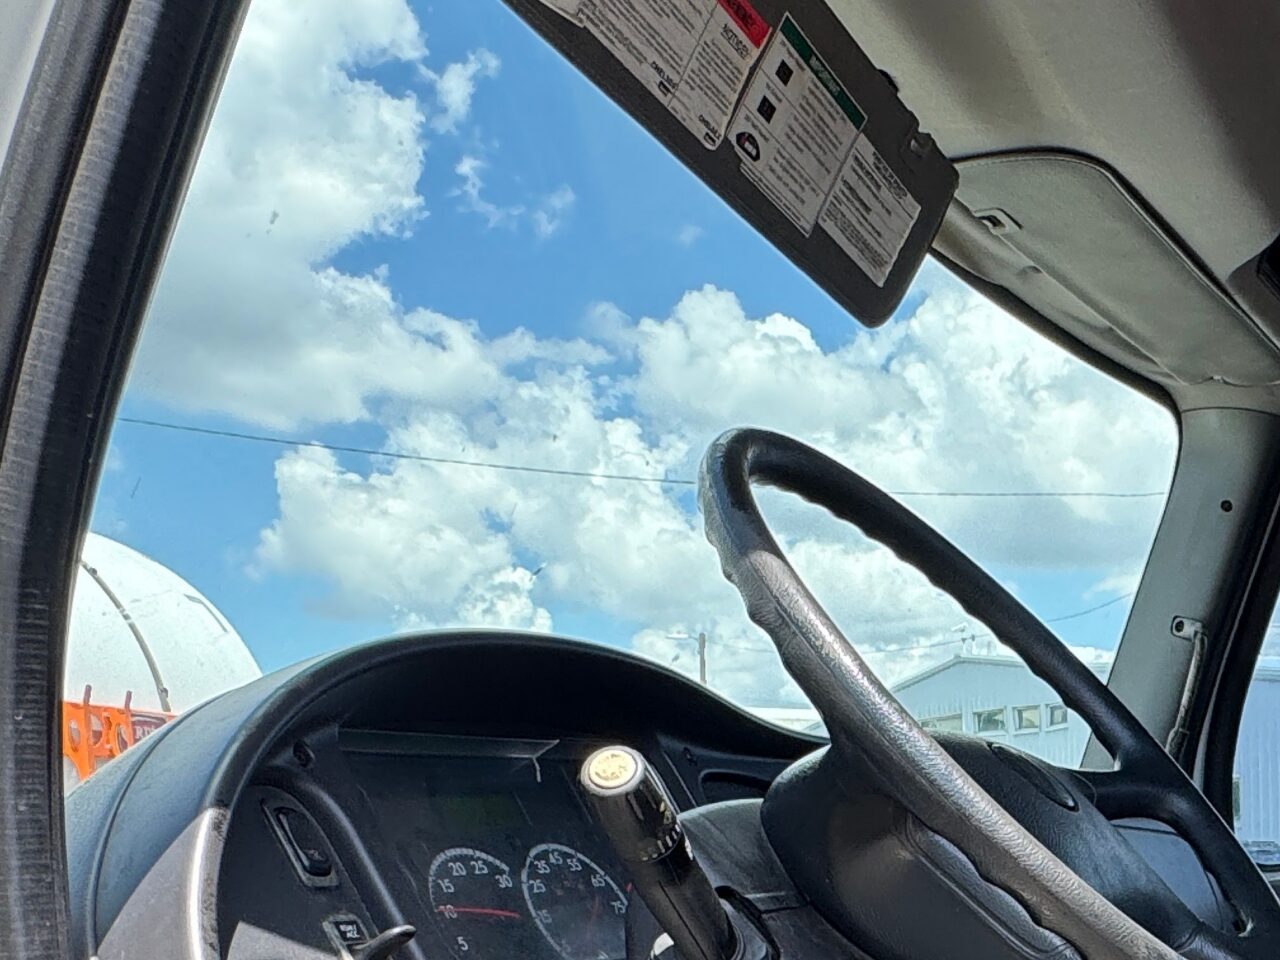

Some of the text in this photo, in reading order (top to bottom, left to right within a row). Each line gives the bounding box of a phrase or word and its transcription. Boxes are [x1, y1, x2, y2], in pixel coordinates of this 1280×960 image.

[549, 851, 563, 865] 45
[567, 858, 582, 872] 55
[448, 861, 467, 876] 20
[470, 860, 488, 875] 25
[534, 860, 550, 874] 35
[438, 878, 455, 893] 15
[495, 874, 513, 888] 30
[529, 879, 546, 893] 25
[591, 873, 606, 888] 65
[611, 901, 626, 914] 75
[456, 936, 469, 951] 5
